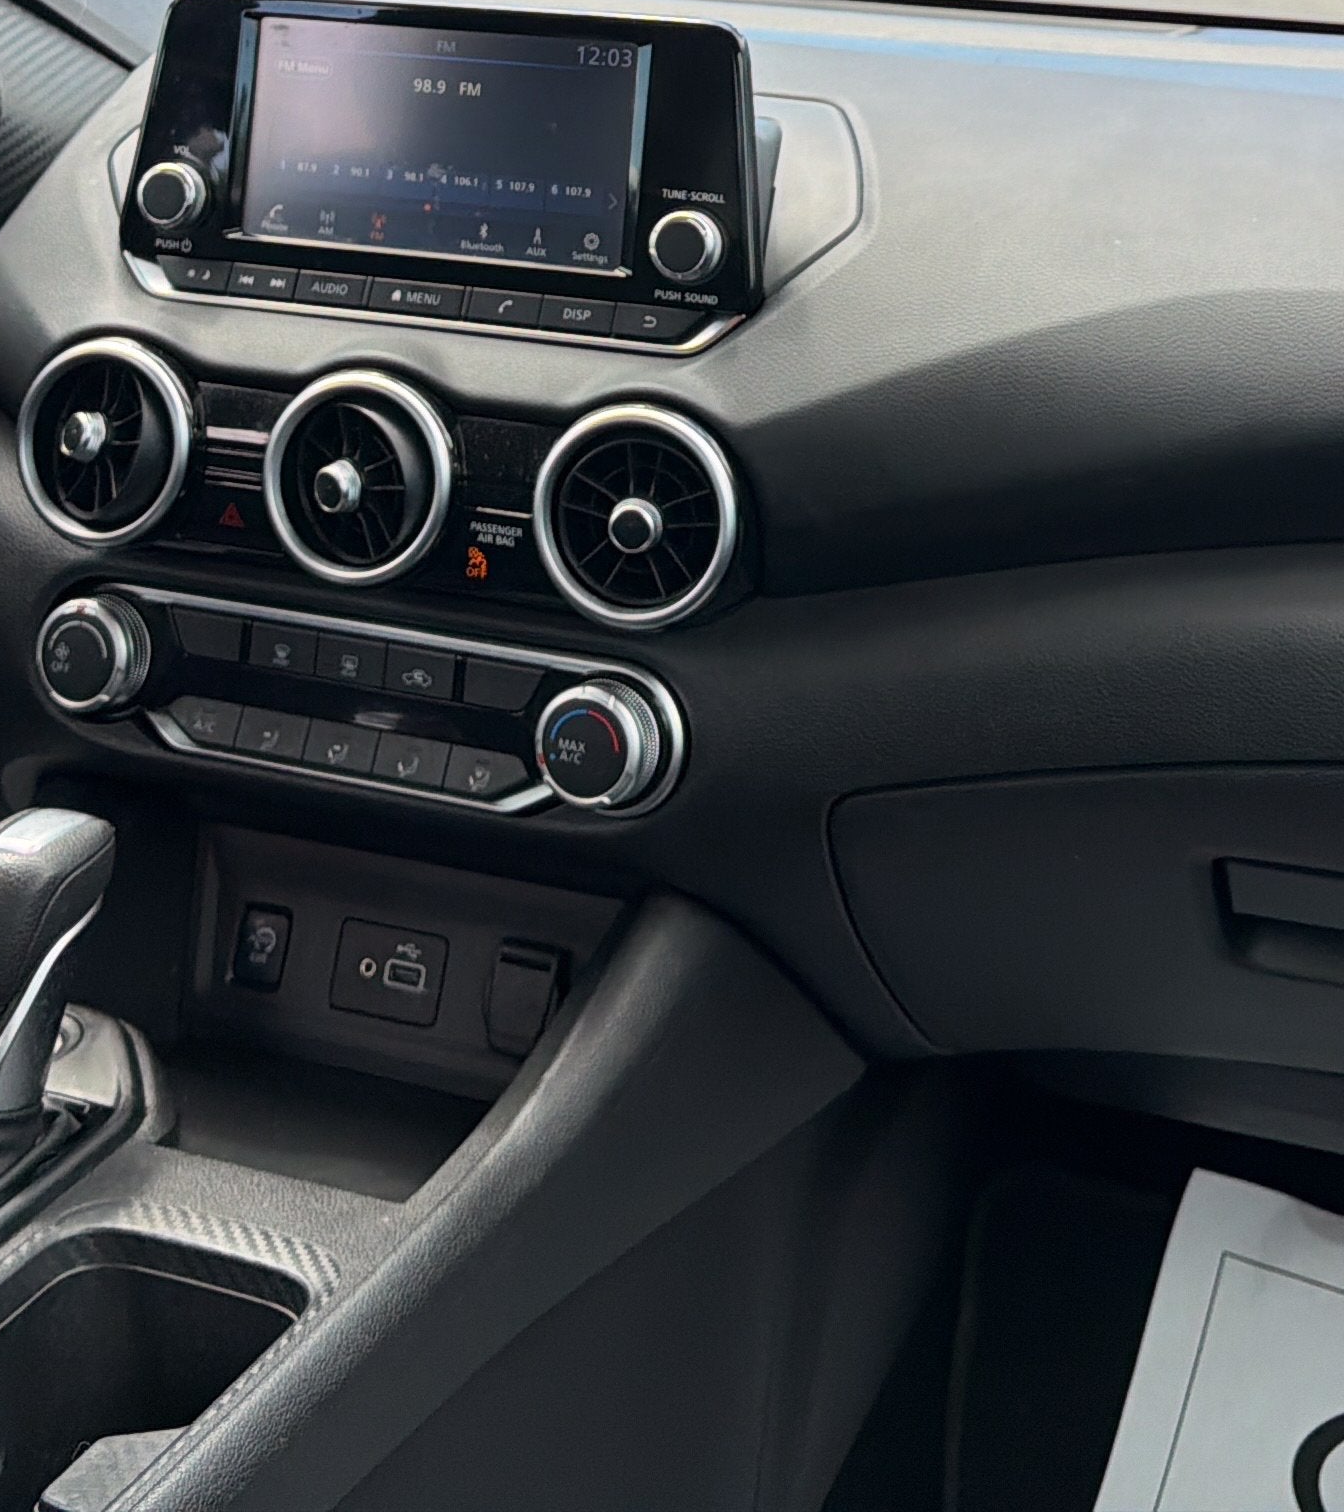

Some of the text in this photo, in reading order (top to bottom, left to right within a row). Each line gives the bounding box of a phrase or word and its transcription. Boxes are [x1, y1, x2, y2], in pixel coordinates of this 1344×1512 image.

[437, 39, 456, 53] FM
[575, 46, 633, 68] 12:03
[413, 78, 482, 97] 98.9 FM
[173, 145, 190, 156] VOL
[509, 180, 535, 193] 107.9
[565, 186, 592, 199] 107.9
[154, 238, 180, 250] PUSH
[460, 239, 504, 253] Bluetooth
[526, 246, 547, 257] AUX
[571, 250, 608, 265] Settings
[311, 280, 349, 297] AUDIO
[406, 290, 442, 306] MENU
[654, 289, 718, 305] PUSH SOUND
[562, 306, 592, 322] DISP
[470, 521, 522, 537] PASSENGER
[477, 532, 515, 547] AIR BAG
[466, 567, 487, 579] OFF
[558, 737, 586, 753] MAX
[559, 751, 582, 765] A/C
